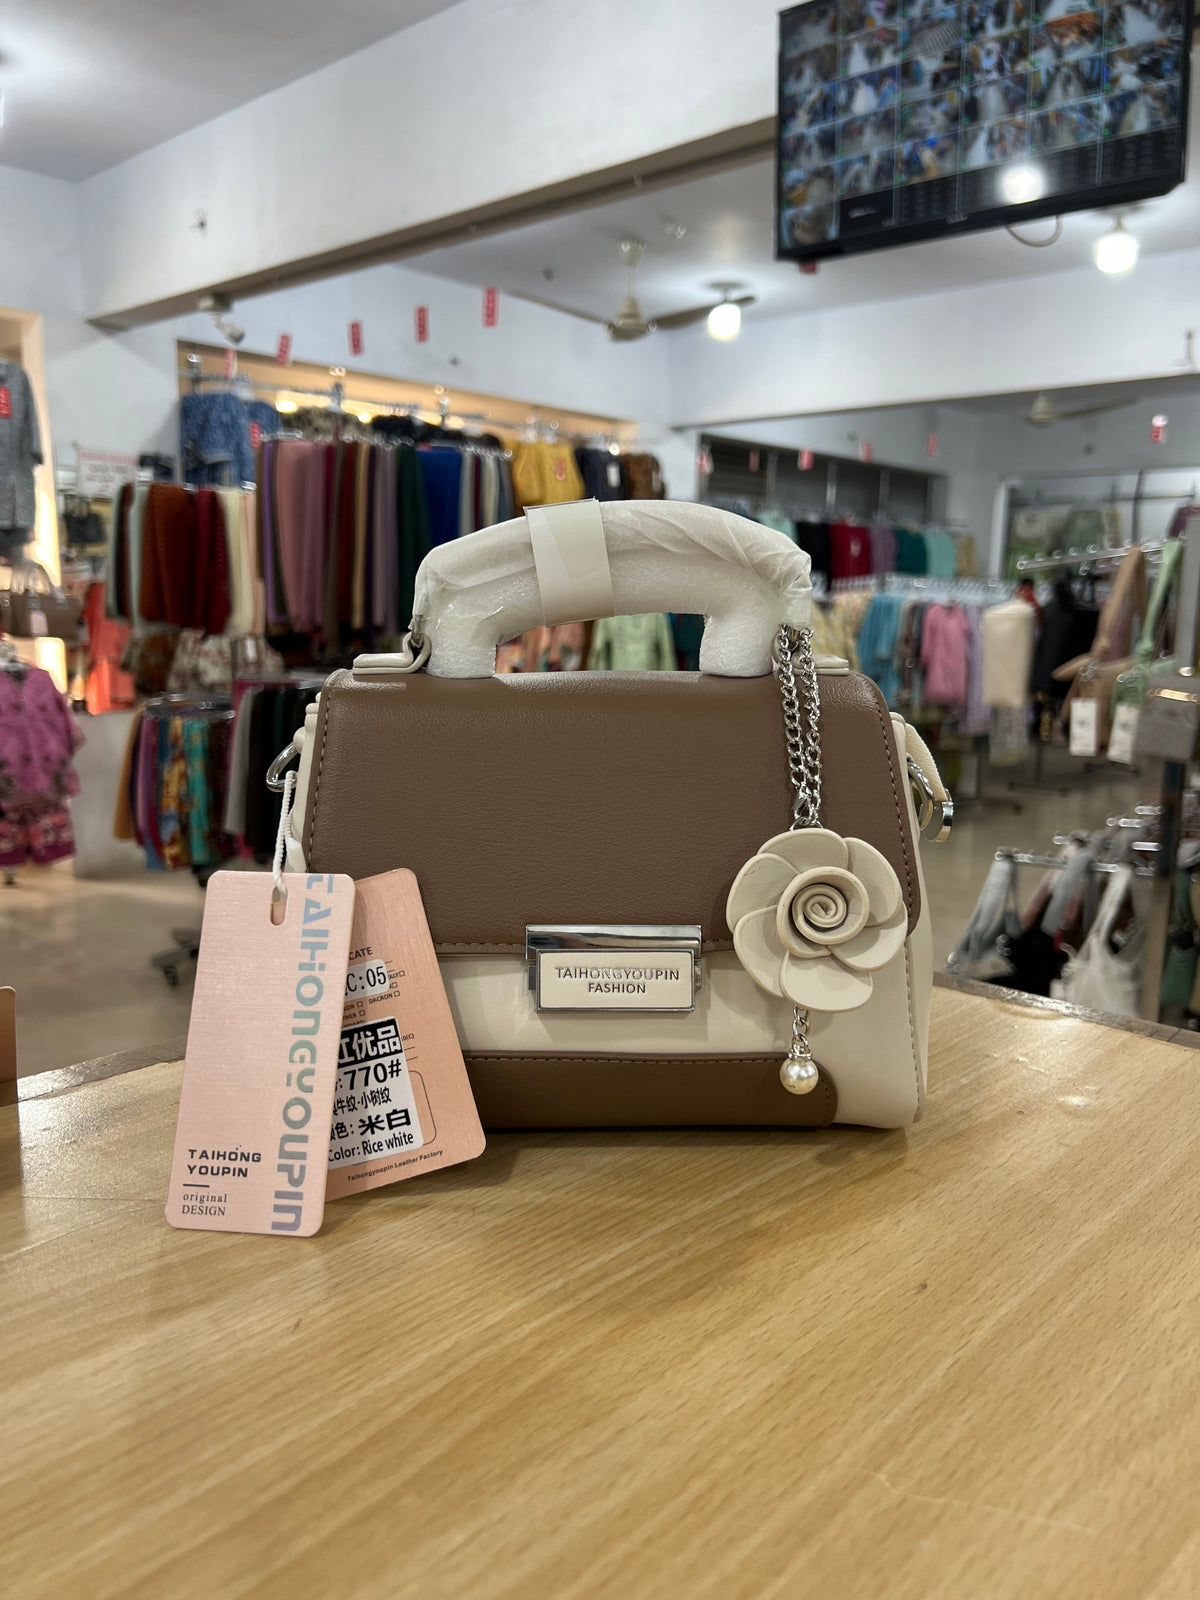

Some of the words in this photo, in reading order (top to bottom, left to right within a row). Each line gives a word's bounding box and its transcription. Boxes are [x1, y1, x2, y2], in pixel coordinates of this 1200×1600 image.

[346, 966, 386, 996] C:05
[555, 967, 680, 981] TAIHONGYOUPIN
[588, 982, 646, 994] FASHION
[361, 1139, 384, 1156] Rice
[385, 1131, 414, 1150] white
[188, 1149, 262, 1163] TAIHONG
[394, 1156, 418, 1168] Leather
[419, 1150, 443, 1161] Factory
[187, 1164, 248, 1178] YOUPIN
[183, 1191, 227, 1204] original
[182, 1204, 226, 1217] DESIGN
